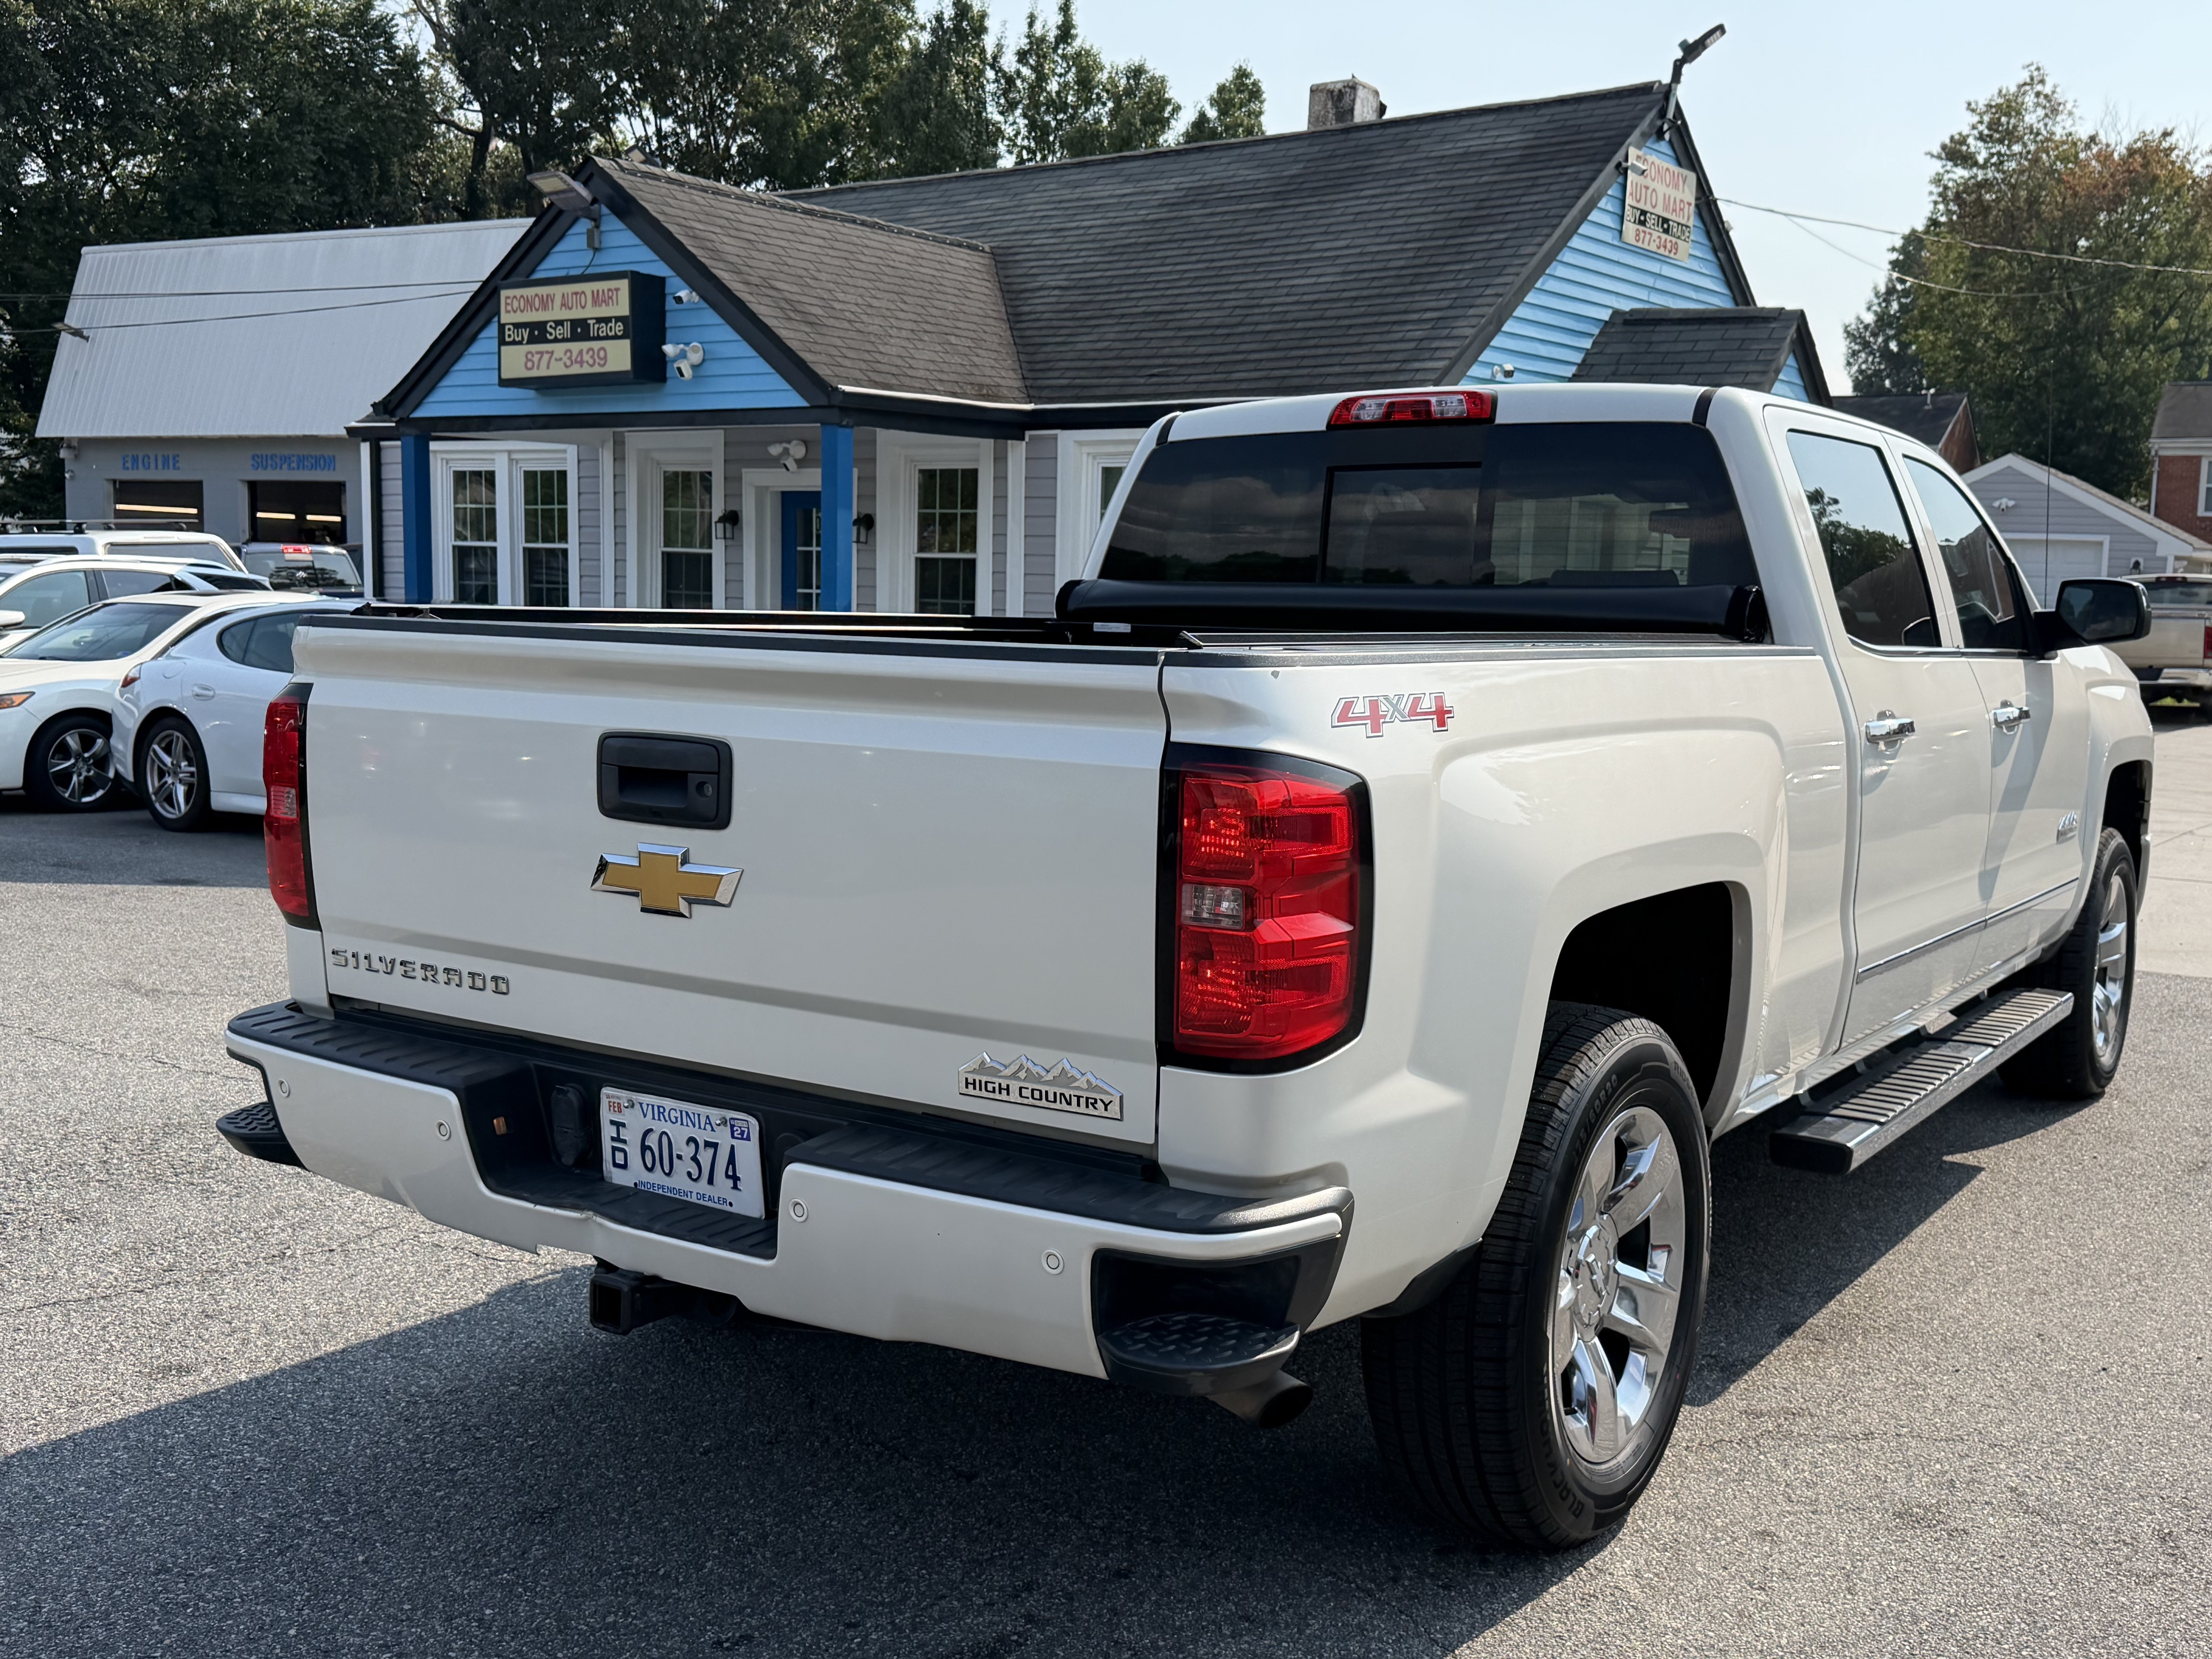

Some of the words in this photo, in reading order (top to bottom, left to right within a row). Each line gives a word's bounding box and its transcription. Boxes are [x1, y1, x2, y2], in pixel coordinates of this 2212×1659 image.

[1628, 180, 1657, 209] AUTO
[1662, 192, 1692, 223] MART
[1626, 206, 1640, 224] BUY
[1646, 213, 1663, 232] SELL
[1669, 221, 1690, 242] TRADE
[1635, 228, 1678, 256] 877-3439
[505, 293, 555, 313] ECONOMY
[560, 290, 587, 310] AUTO
[592, 287, 620, 307] MART
[505, 325, 529, 344] Buy
[546, 321, 570, 340] Sell
[587, 318, 623, 337] Trade
[524, 347, 607, 371] 877-3439
[122, 454, 180, 470] ENGINE
[251, 453, 336, 471] SUSPENSION
[331, 947, 509, 995] SILVERADO
[608, 1100, 622, 1113] FEB
[965, 1077, 1010, 1096] HIGH
[1018, 1086, 1113, 1112] COUNTRY
[638, 1102, 716, 1133] VIRGINIA
[733, 1126, 748, 1138] 27
[640, 1127, 742, 1192] 60-374
[638, 1180, 693, 1200] INDEPENDENT
[696, 1192, 728, 1207] DEALER
